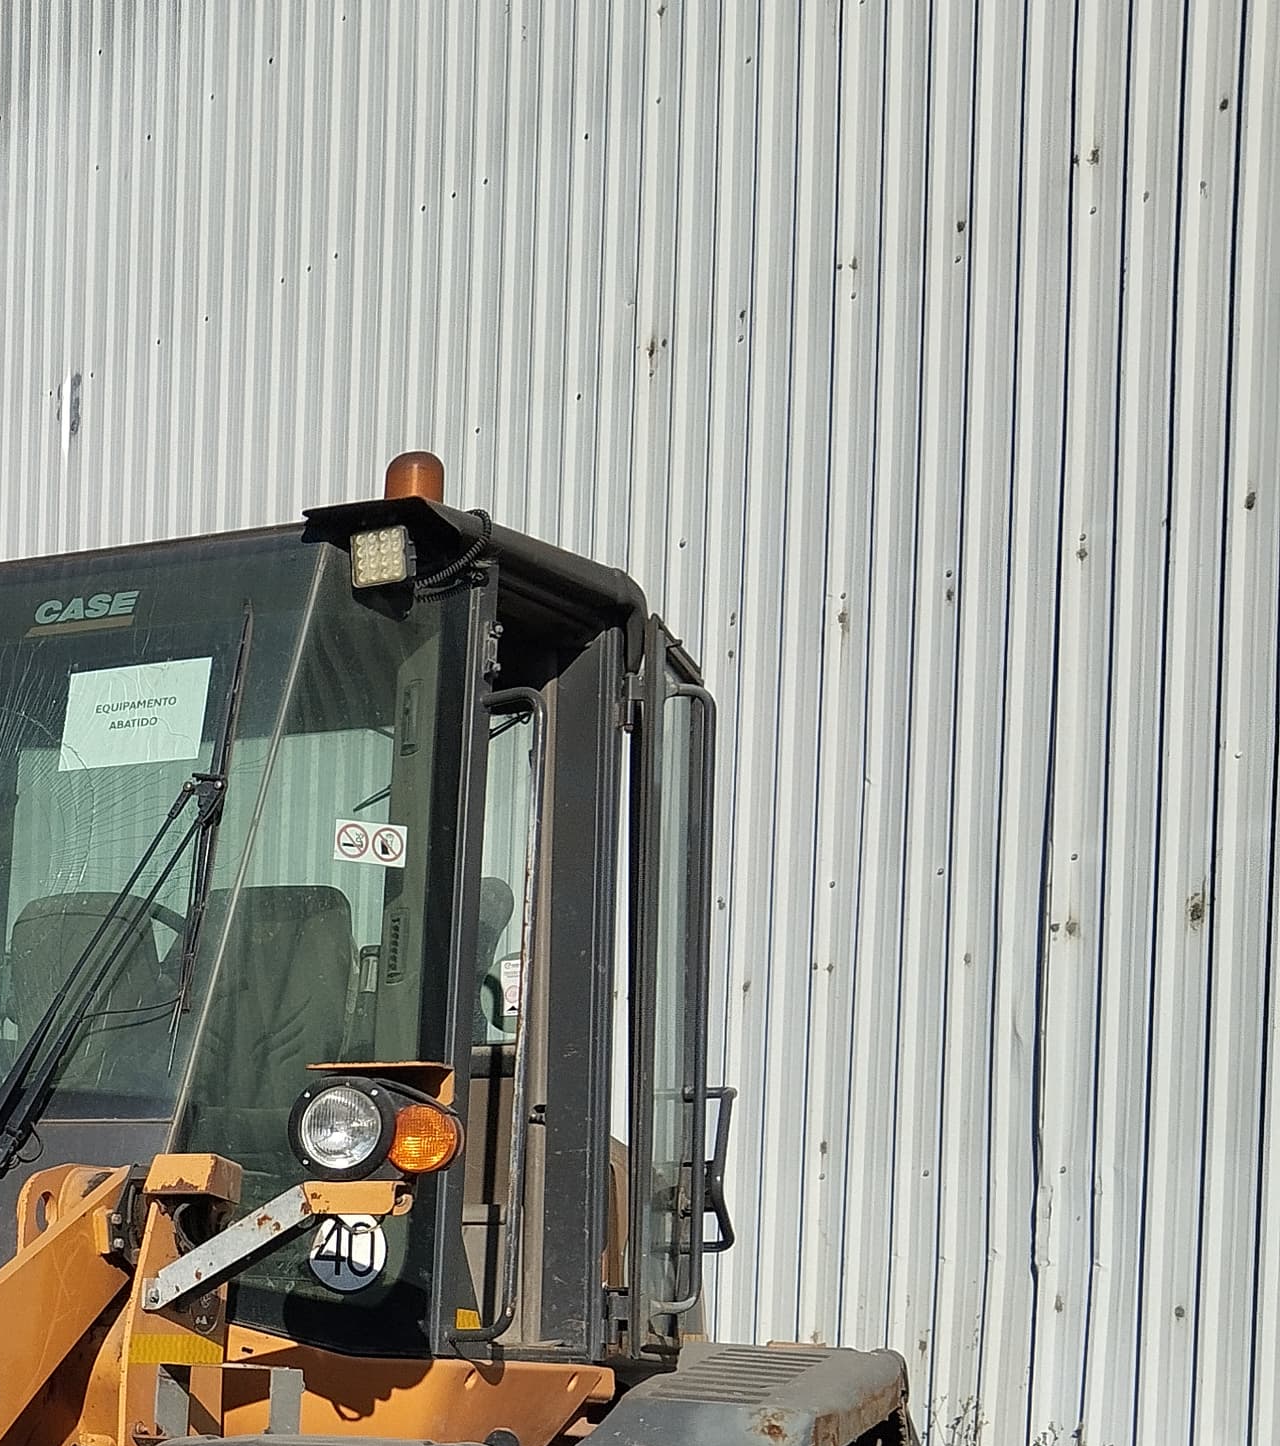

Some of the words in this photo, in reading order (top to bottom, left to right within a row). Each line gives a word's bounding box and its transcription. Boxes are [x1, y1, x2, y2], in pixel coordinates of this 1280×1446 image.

[34, 590, 140, 625] CASE
[95, 696, 177, 714] EQUIPAMENTO
[109, 716, 158, 730] ABATIDO
[314, 1221, 375, 1278] 40
